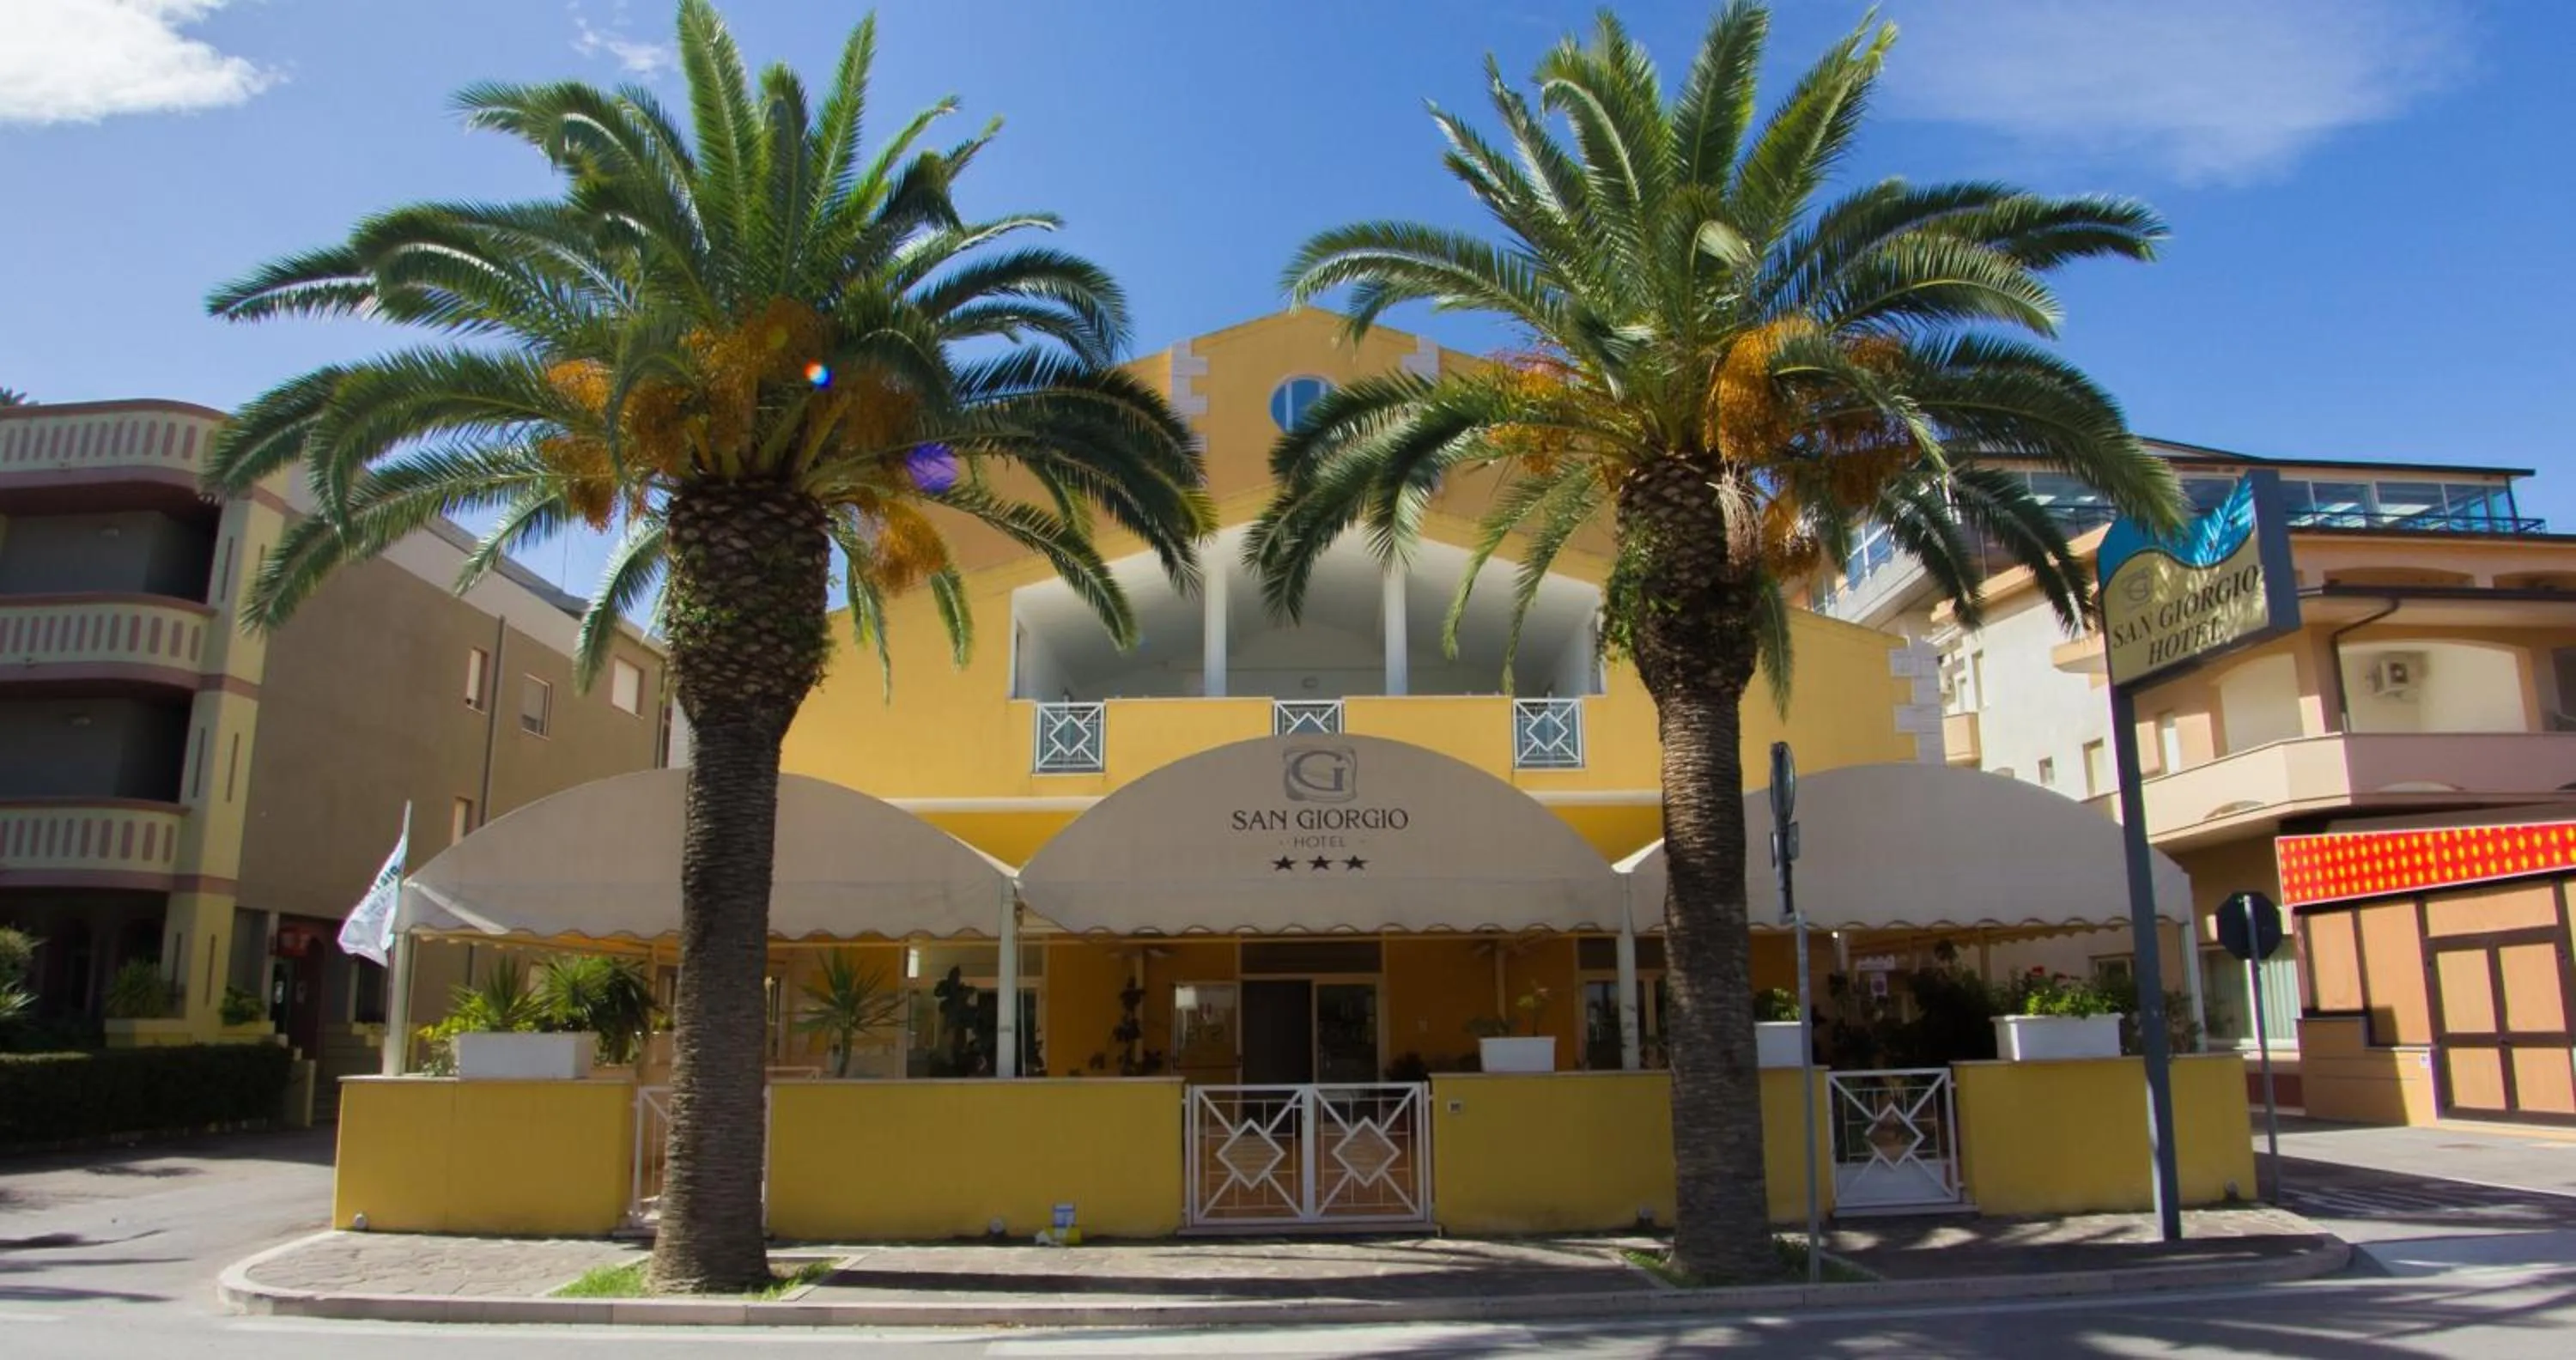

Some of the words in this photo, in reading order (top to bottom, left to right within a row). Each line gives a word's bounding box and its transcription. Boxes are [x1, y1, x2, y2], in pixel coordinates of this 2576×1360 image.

[2112, 613, 2154, 648] SAN
[2159, 564, 2258, 630] GIORGIO
[2148, 616, 2224, 666] HOTEL
[1231, 810, 1288, 831] SAN
[1296, 808, 1409, 830] GIORGIO
[1293, 835, 1347, 848] HOTEL
